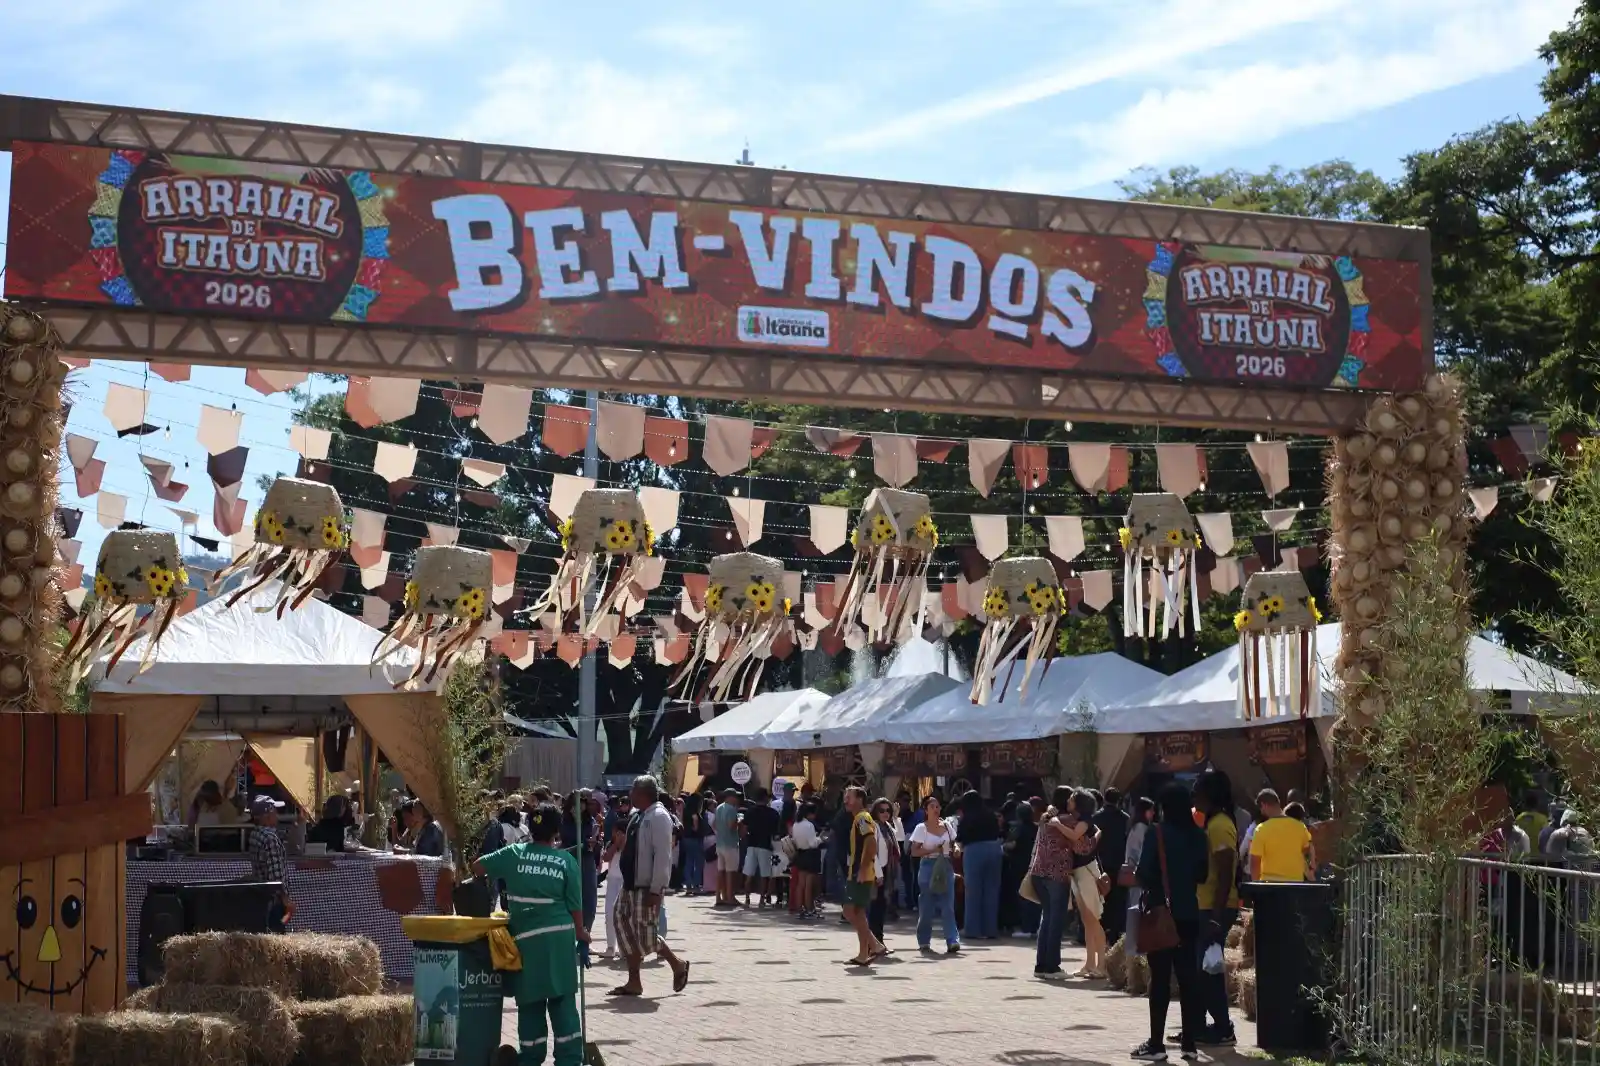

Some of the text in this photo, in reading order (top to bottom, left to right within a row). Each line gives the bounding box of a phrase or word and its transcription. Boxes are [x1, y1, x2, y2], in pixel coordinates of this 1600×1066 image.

[143, 178, 340, 235] ARRAIAL
[230, 219, 256, 237] DE
[161, 231, 322, 277] ITAÚNA
[431, 193, 1096, 349] BEM-VINDOS
[204, 281, 272, 309] 2026
[1183, 265, 1333, 312] ARRAIAL
[1250, 300, 1271, 315] DE
[1200, 312, 1323, 350] ITAÚNA
[1235, 354, 1286, 378] 2026
[516, 864, 565, 881] URBANA
[519, 851, 567, 869] LIMPEZA
